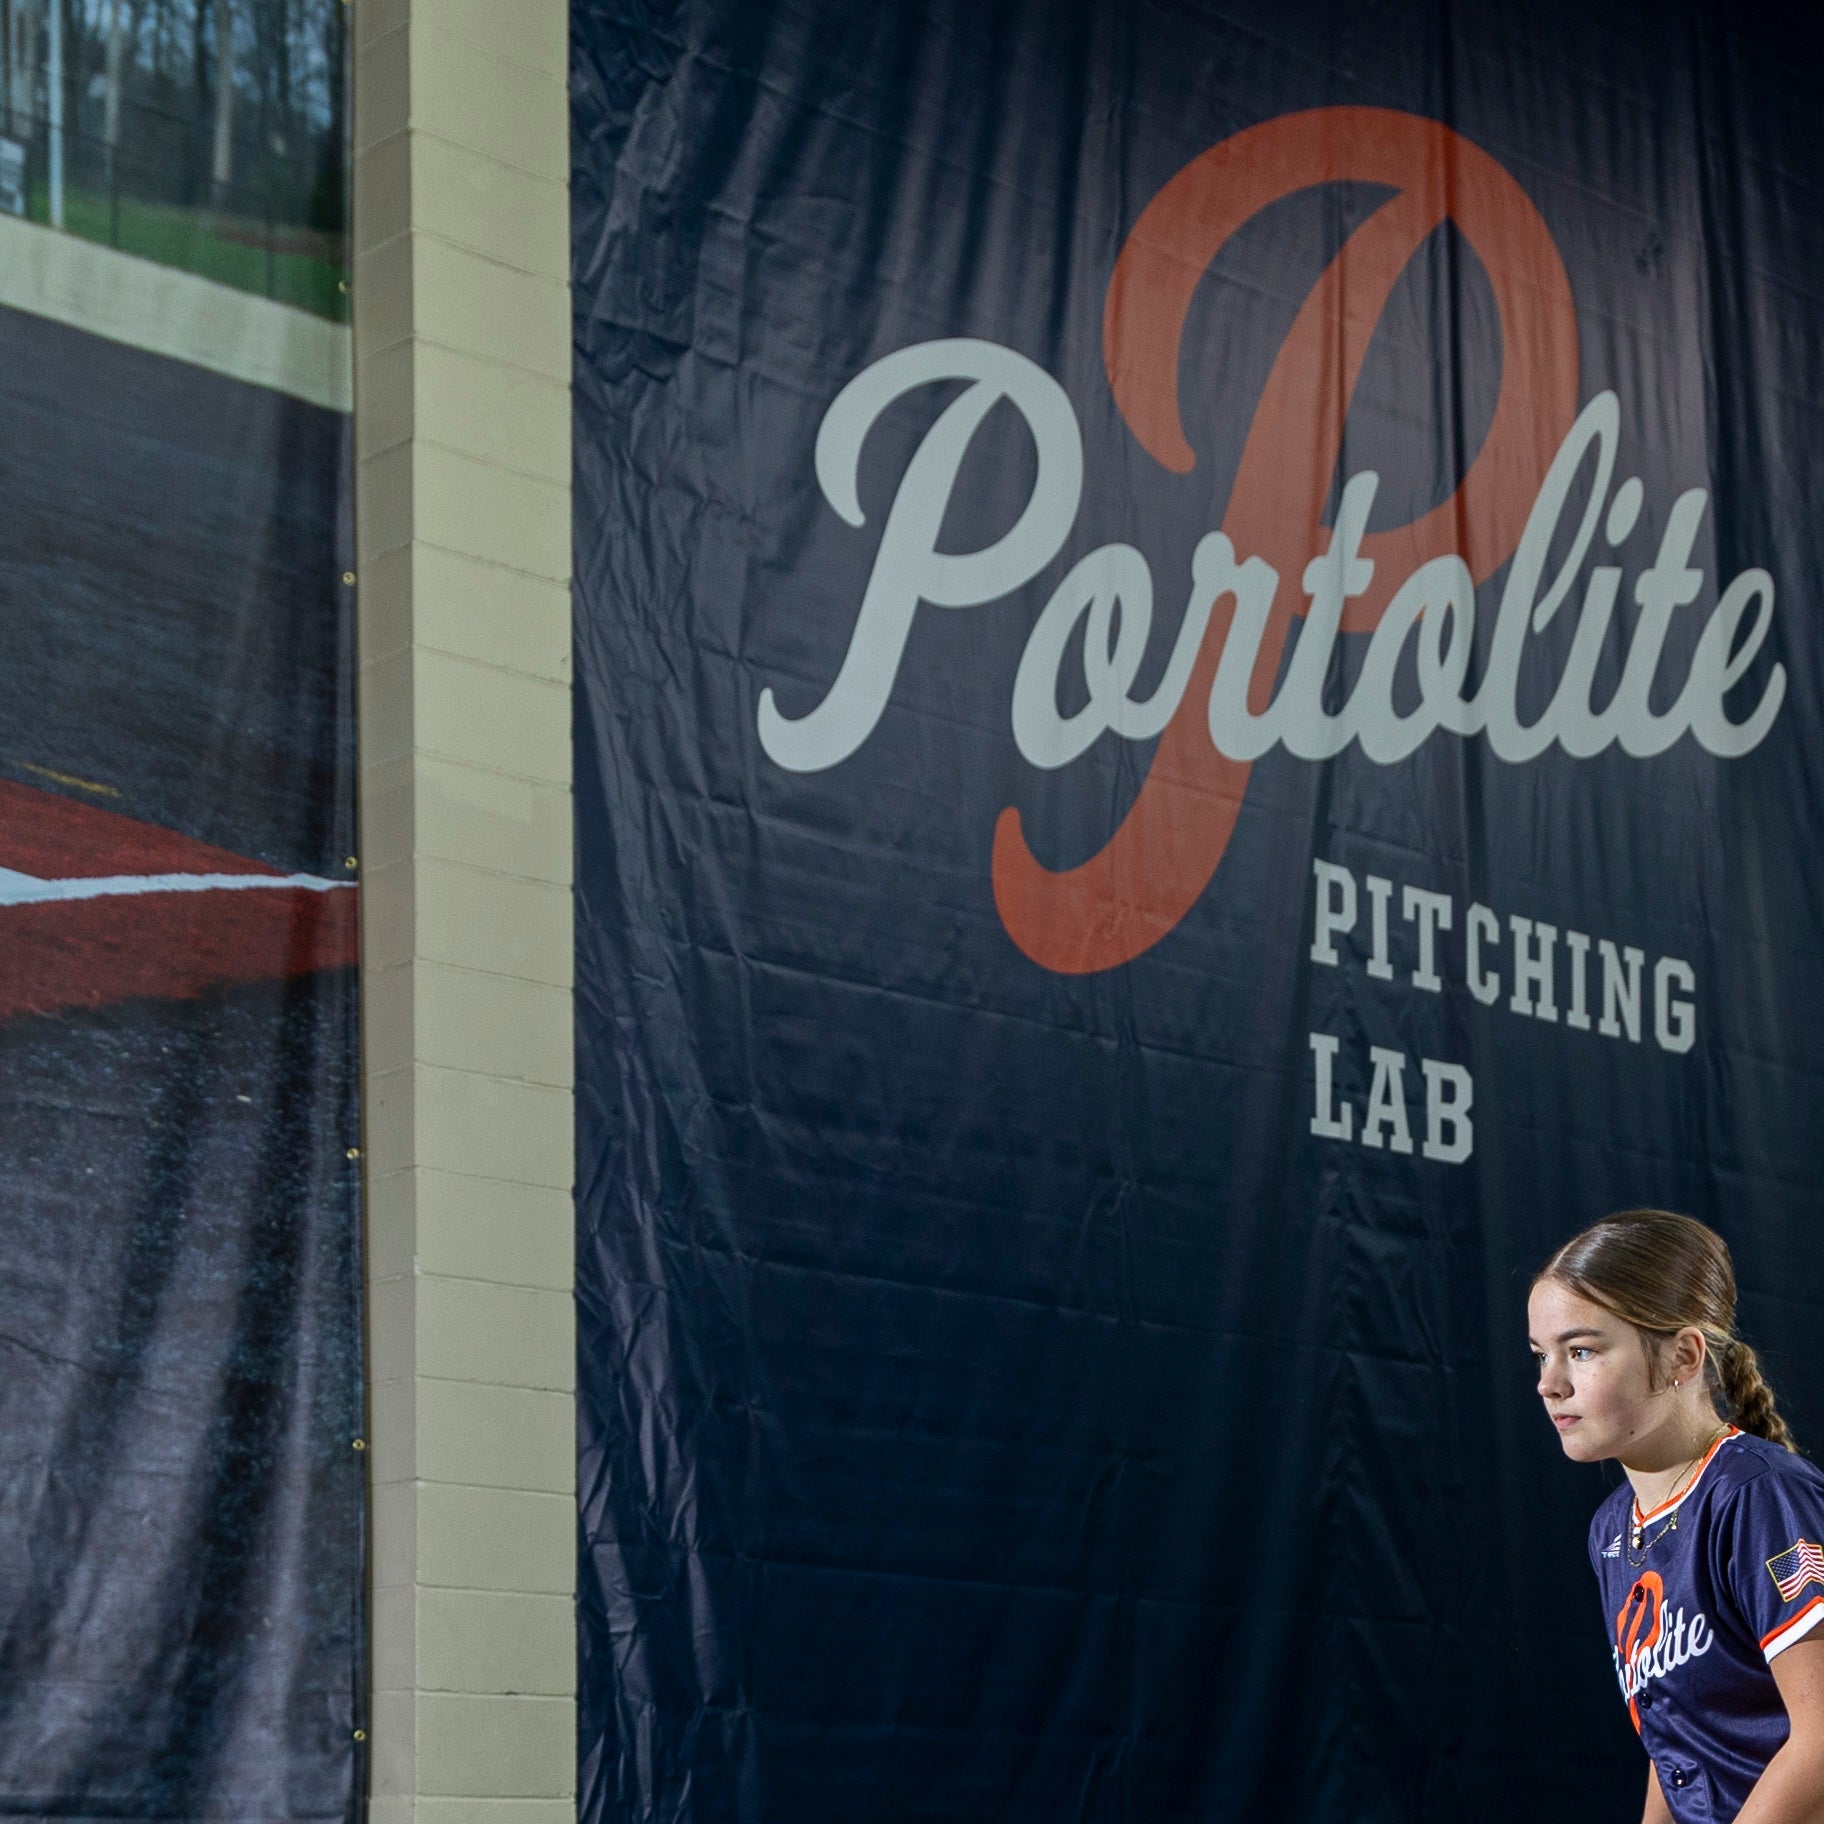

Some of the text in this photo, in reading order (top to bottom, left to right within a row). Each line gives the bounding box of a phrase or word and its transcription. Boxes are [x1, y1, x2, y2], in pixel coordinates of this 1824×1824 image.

[757, 338, 1785, 772] Portolite
[1310, 858, 1697, 1055] PITCHING
[1310, 1033, 1475, 1164] LAB
